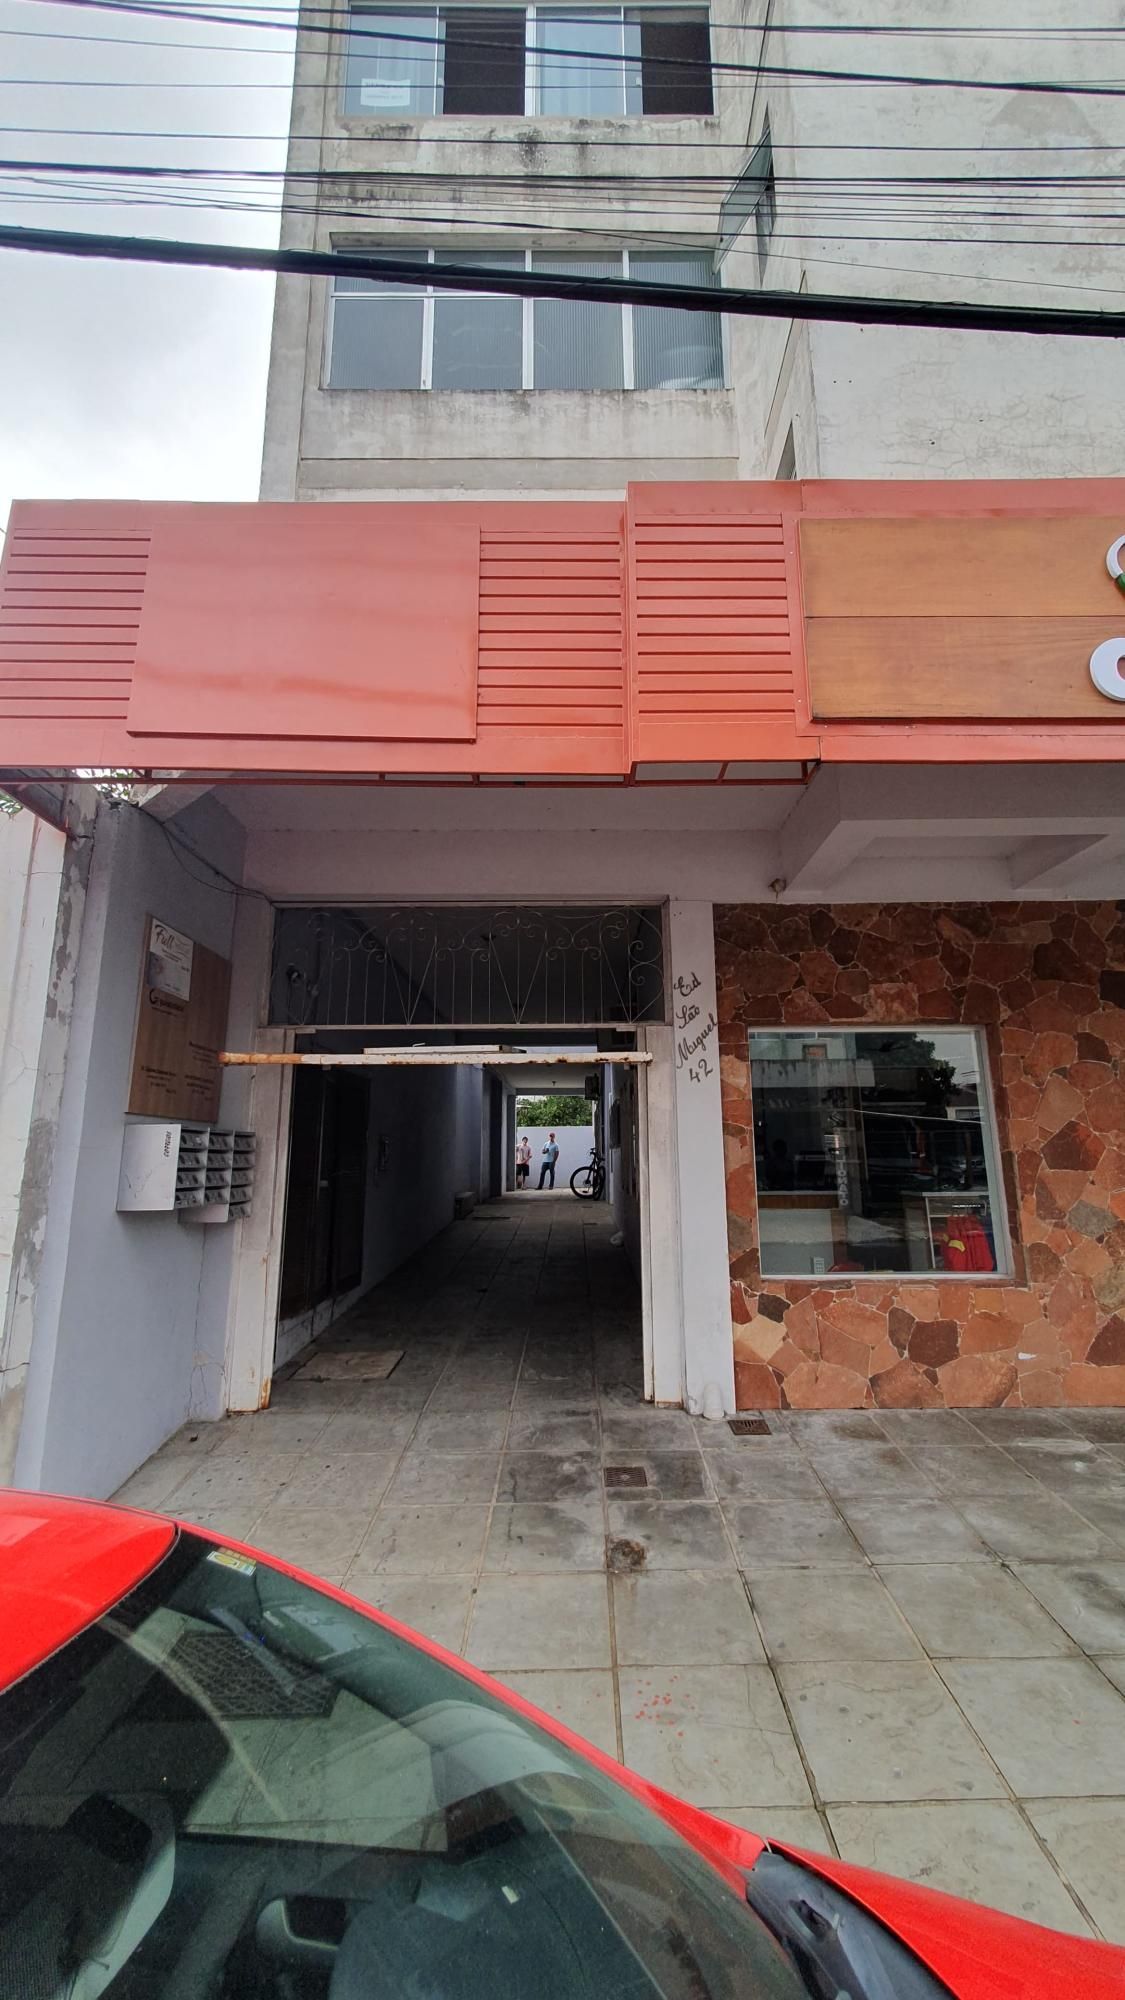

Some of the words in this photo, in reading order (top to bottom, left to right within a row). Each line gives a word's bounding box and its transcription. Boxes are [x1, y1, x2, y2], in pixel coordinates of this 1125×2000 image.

[674, 971, 702, 997] Ed
[676, 1004, 701, 1029] São
[676, 1013, 718, 1069] Miguel
[689, 1058, 713, 1083] 42
